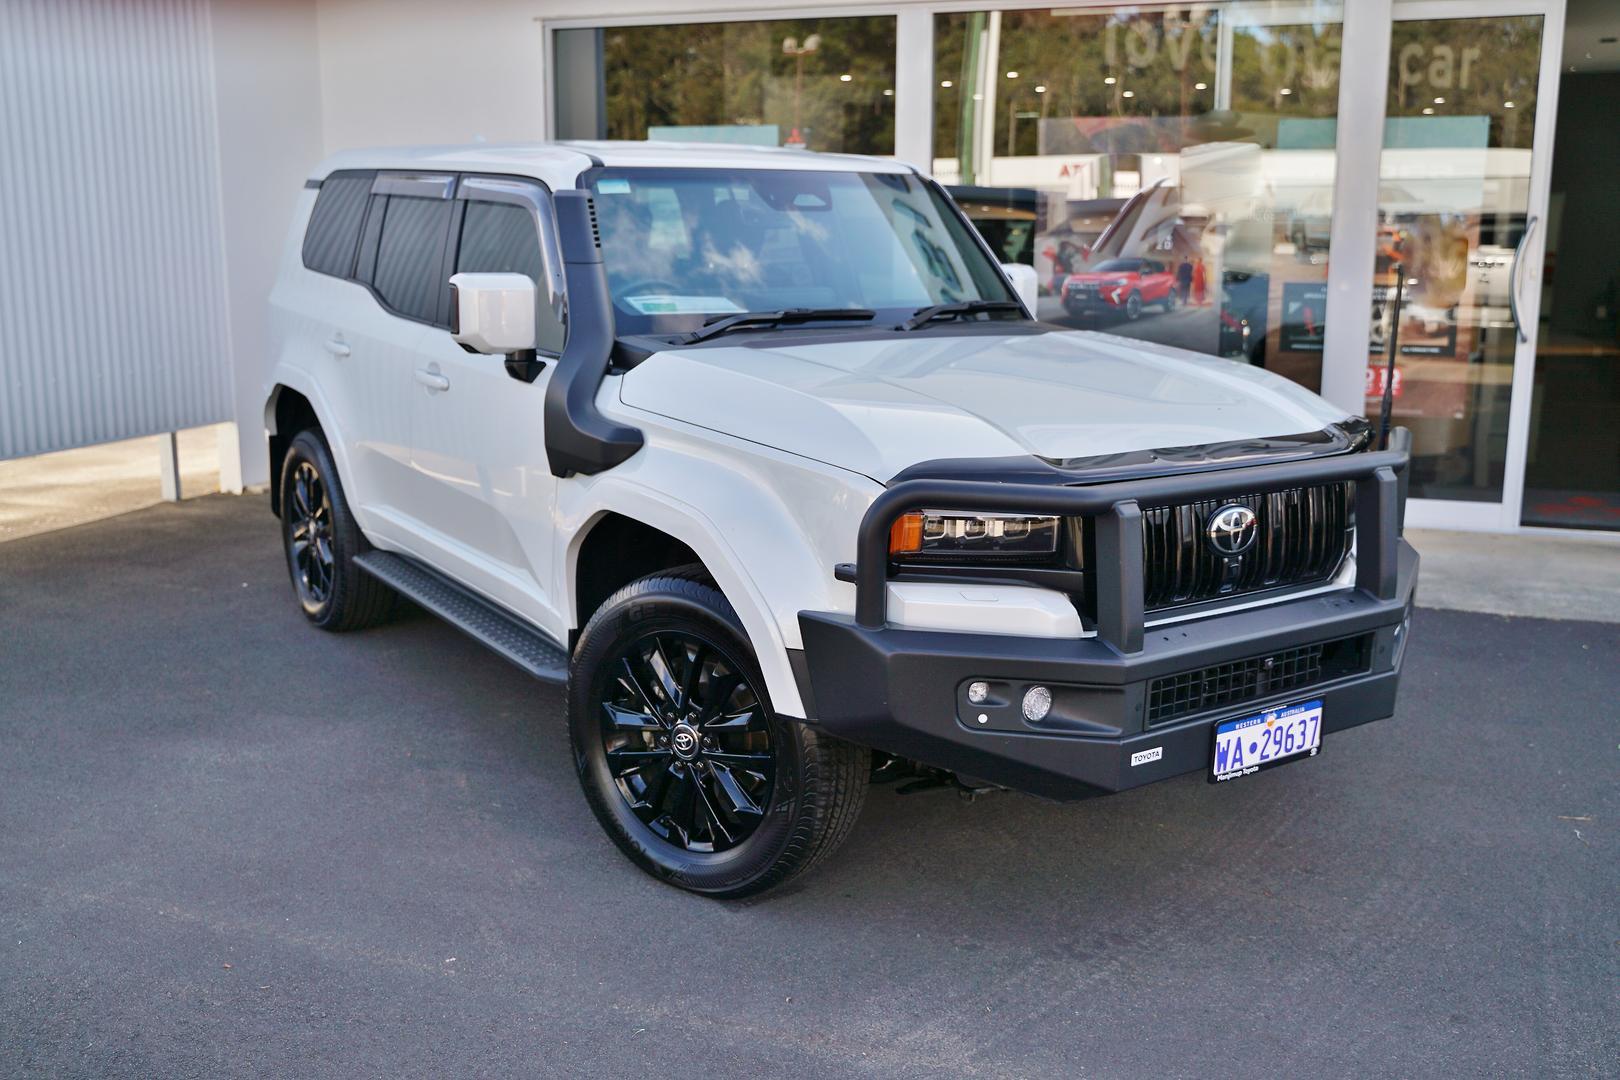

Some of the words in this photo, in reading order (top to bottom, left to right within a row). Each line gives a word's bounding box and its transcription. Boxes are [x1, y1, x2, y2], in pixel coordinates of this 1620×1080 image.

[1399, 42, 1481, 91] car
[1235, 718, 1261, 730] WESTERN
[1280, 706, 1305, 718] AUSTRALIA
[1133, 750, 1160, 763] TOYOTA
[1243, 766, 1260, 776] Toyota
